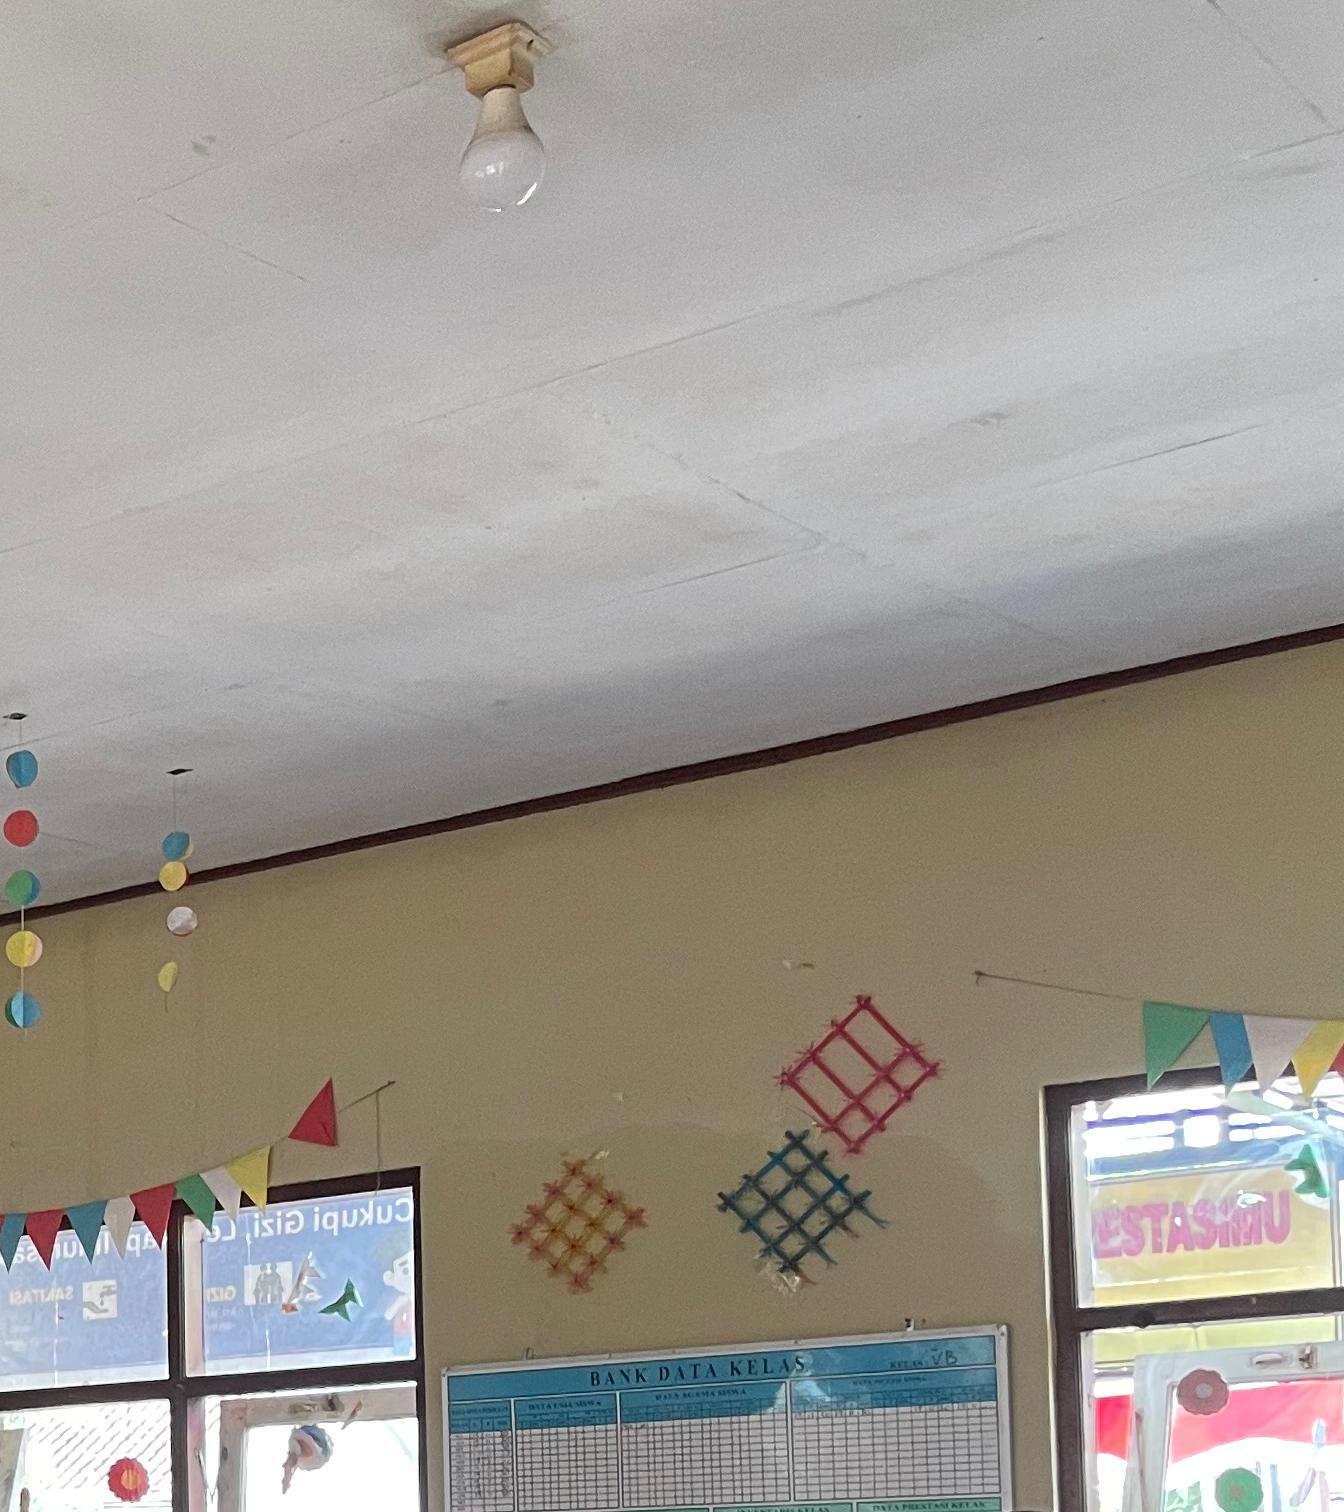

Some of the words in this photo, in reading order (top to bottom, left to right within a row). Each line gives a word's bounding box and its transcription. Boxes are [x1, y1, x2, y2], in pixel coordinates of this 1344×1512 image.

[590, 1366, 648, 1387] BANK
[658, 1363, 718, 1382] DATA
[730, 1356, 806, 1376] KELAS
